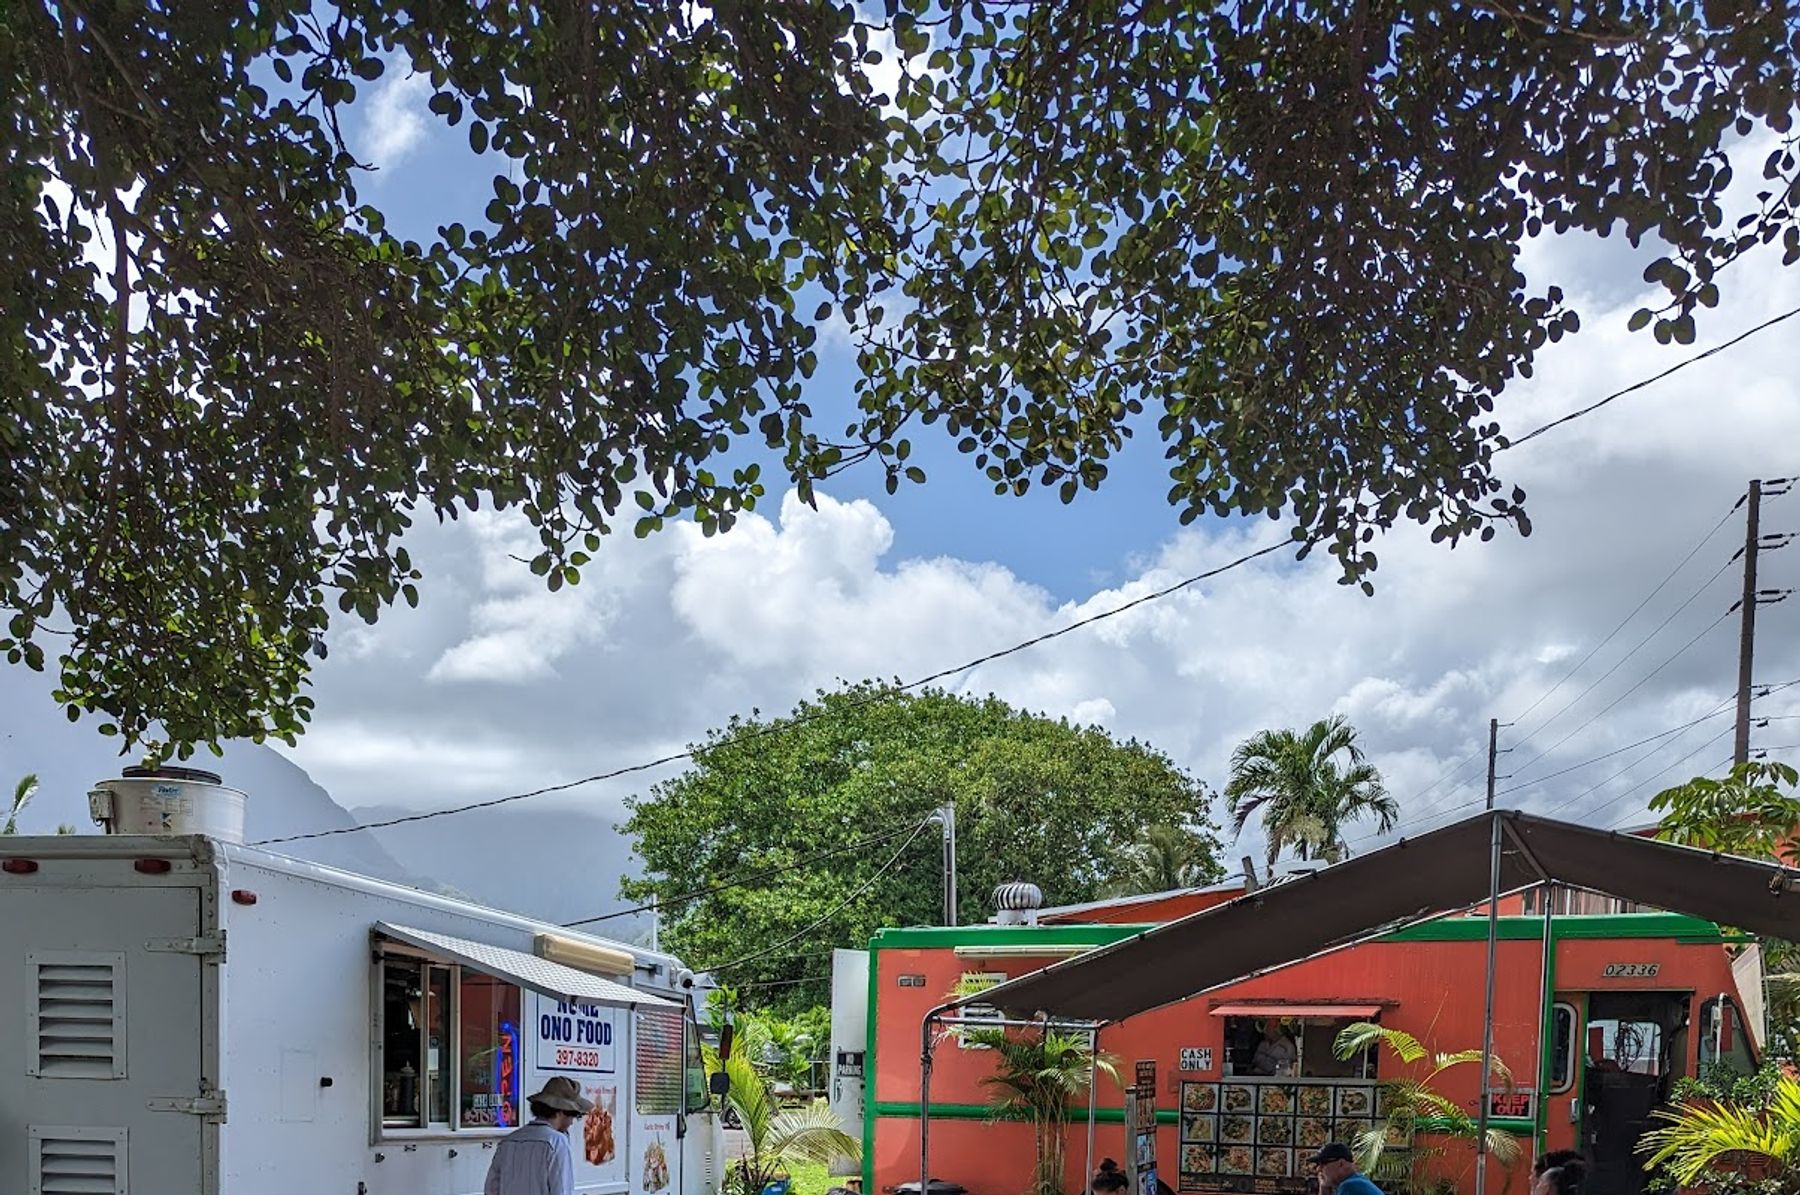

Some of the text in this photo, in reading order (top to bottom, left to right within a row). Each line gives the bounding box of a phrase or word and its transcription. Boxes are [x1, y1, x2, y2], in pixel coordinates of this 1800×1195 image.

[1605, 964, 1658, 976] 02336
[540, 1014, 612, 1046] ONO FOOD
[555, 1049, 599, 1068] 397-8320
[1181, 1048, 1212, 1059] CASH
[1181, 1059, 1211, 1070] ONLY
[1496, 1105, 1525, 1115] OUT
